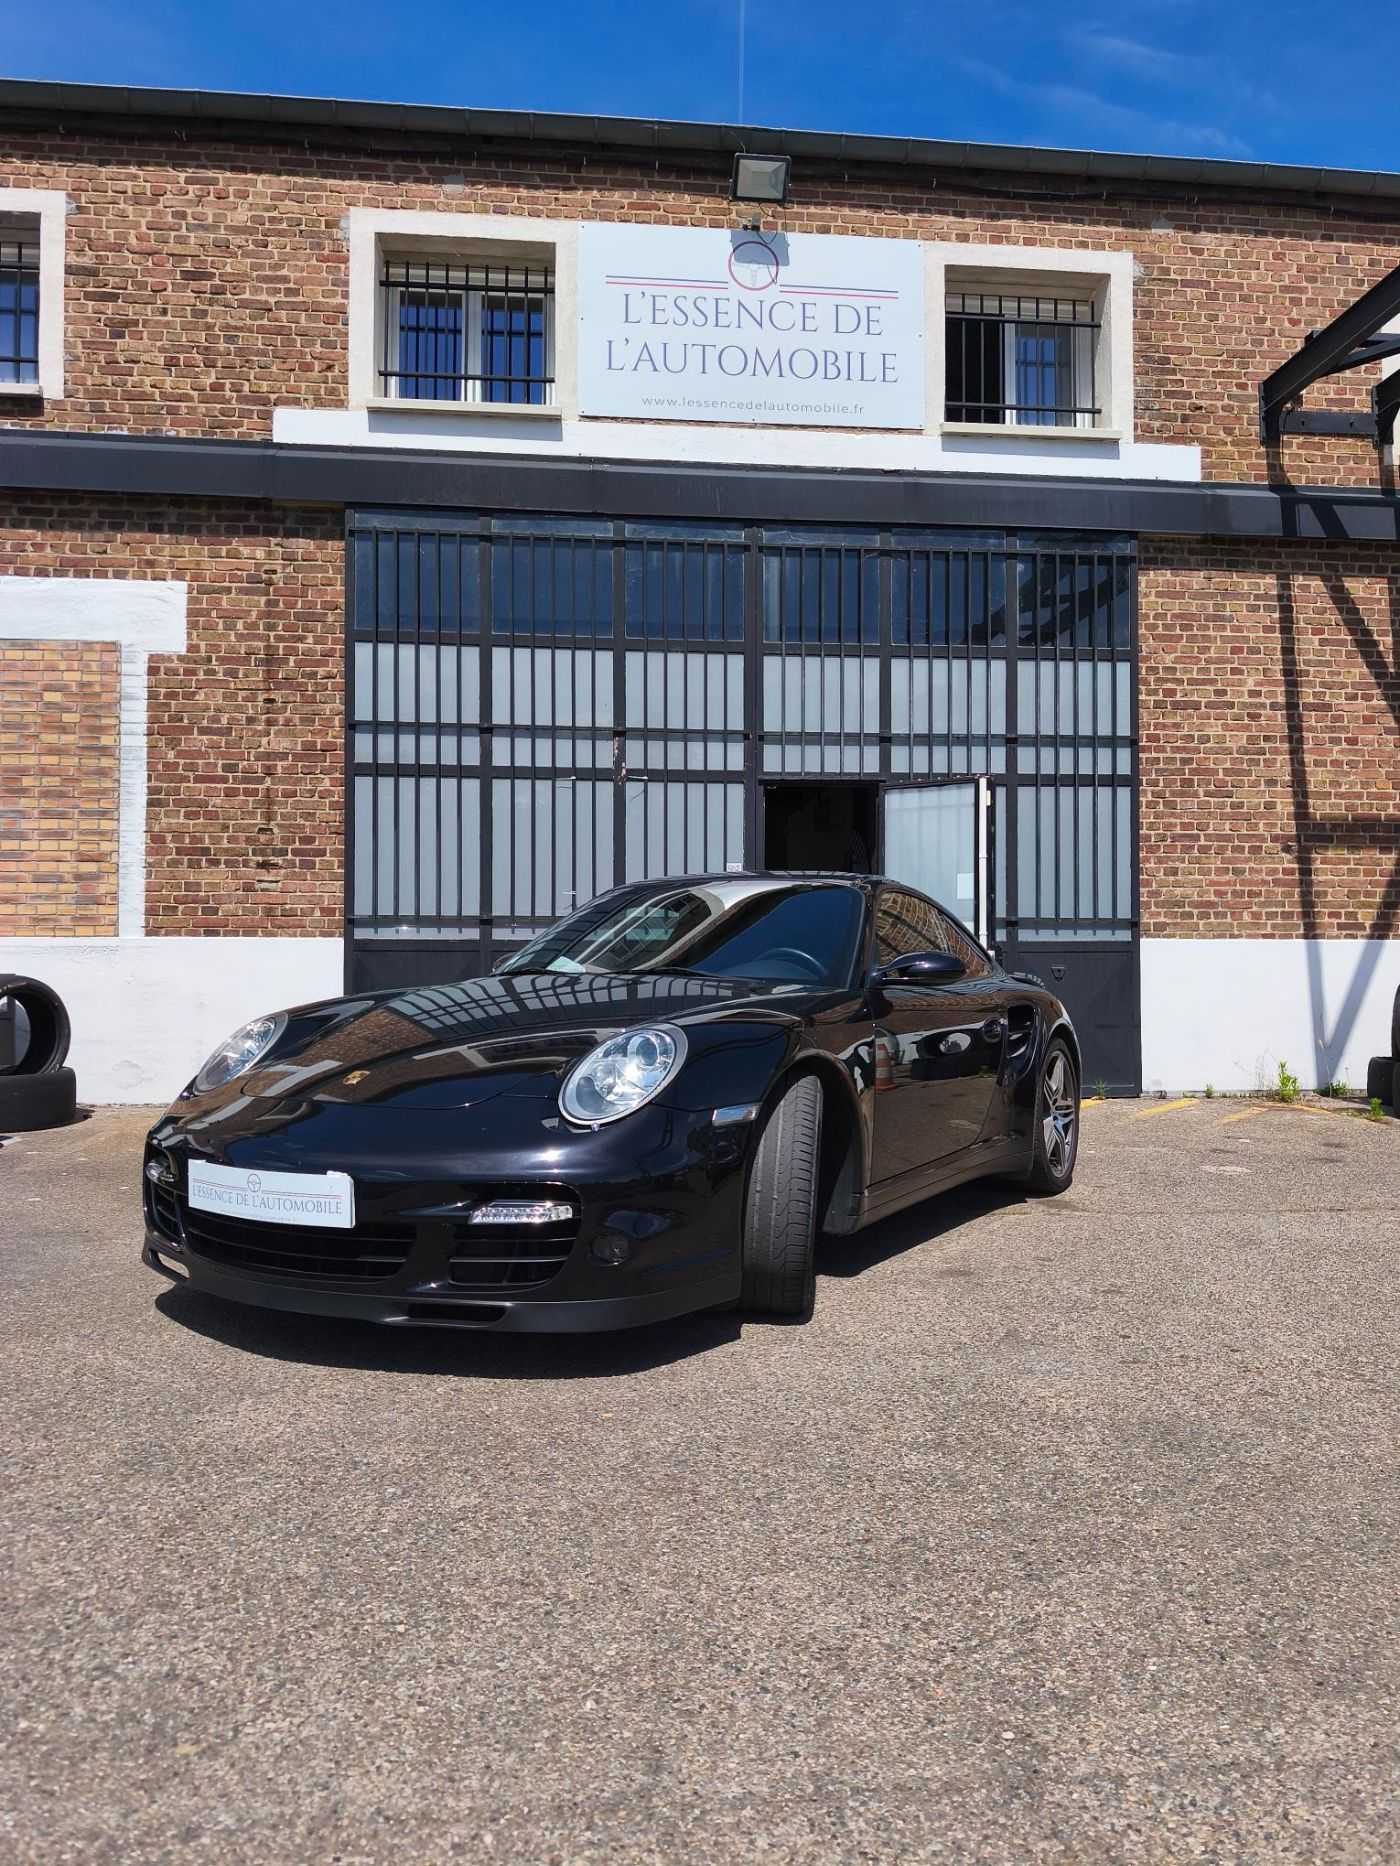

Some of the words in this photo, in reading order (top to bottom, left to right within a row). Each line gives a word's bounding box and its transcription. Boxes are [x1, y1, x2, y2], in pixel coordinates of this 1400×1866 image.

[623, 291, 818, 333] L'ESSENCE
[832, 304, 883, 336] DE
[606, 337, 899, 384] L'AUTOMOBILE
[641, 395, 865, 416] www.lessencedelautomobile.fr
[192, 1183, 232, 1205] L'ESSENCE
[236, 1192, 250, 1207] DE
[252, 1194, 343, 1215] L'AUTOMOBILE
